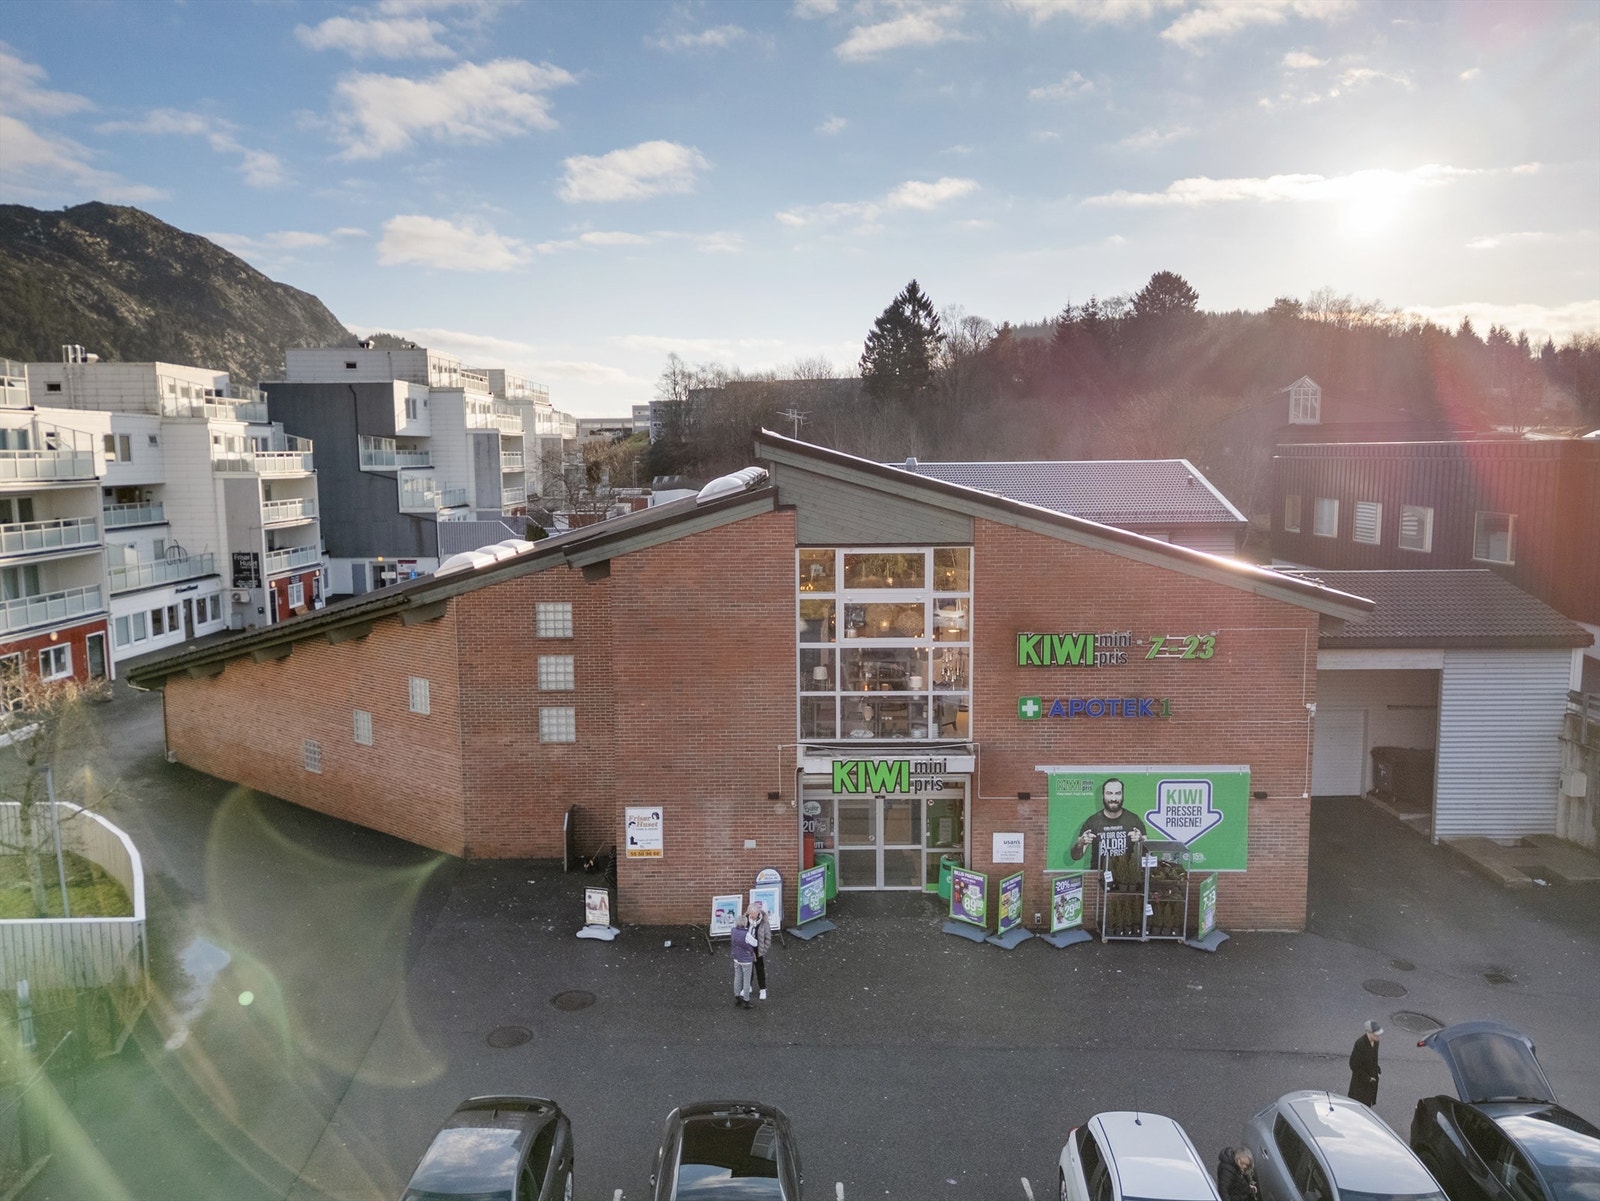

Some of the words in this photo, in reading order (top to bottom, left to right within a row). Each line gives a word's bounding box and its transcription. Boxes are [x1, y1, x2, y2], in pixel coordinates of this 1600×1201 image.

[1017, 633, 1095, 667] KIWI
[1099, 631, 1132, 647] mini
[1099, 649, 1128, 666] pris
[1049, 697, 1155, 718] APOTEK
[1159, 697, 1173, 718] 1
[832, 760, 910, 793] KIWI
[914, 758, 947, 774] mini
[914, 776, 943, 794] pris
[1056, 779, 1082, 791] KIWI
[1166, 789, 1202, 805] KIWI
[1166, 806, 1202, 816] PRESSER
[1166, 817, 1201, 827] PRISENE!
[1100, 838, 1126, 849] ALDRI
